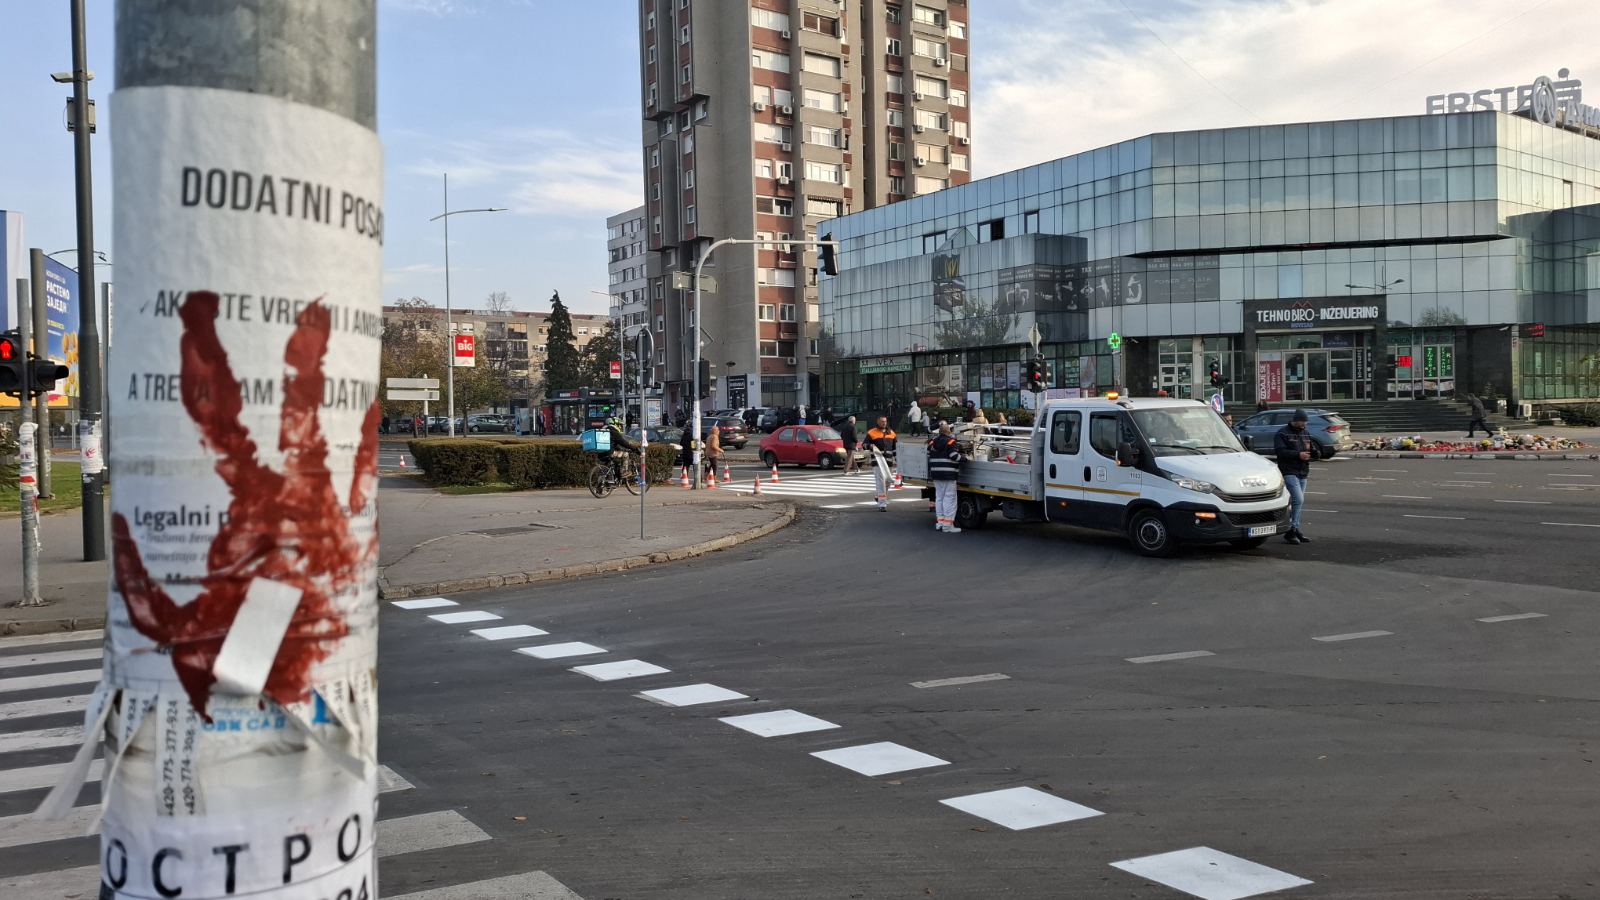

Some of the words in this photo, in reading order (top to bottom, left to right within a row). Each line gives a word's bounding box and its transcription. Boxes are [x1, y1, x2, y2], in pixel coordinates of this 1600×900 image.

[181, 166, 331, 225] DODATNI
[128, 373, 138, 400] A
[224, 377, 273, 405] AM
[135, 505, 210, 532] Legalni
[181, 701, 198, 816] +420-774-308-34
